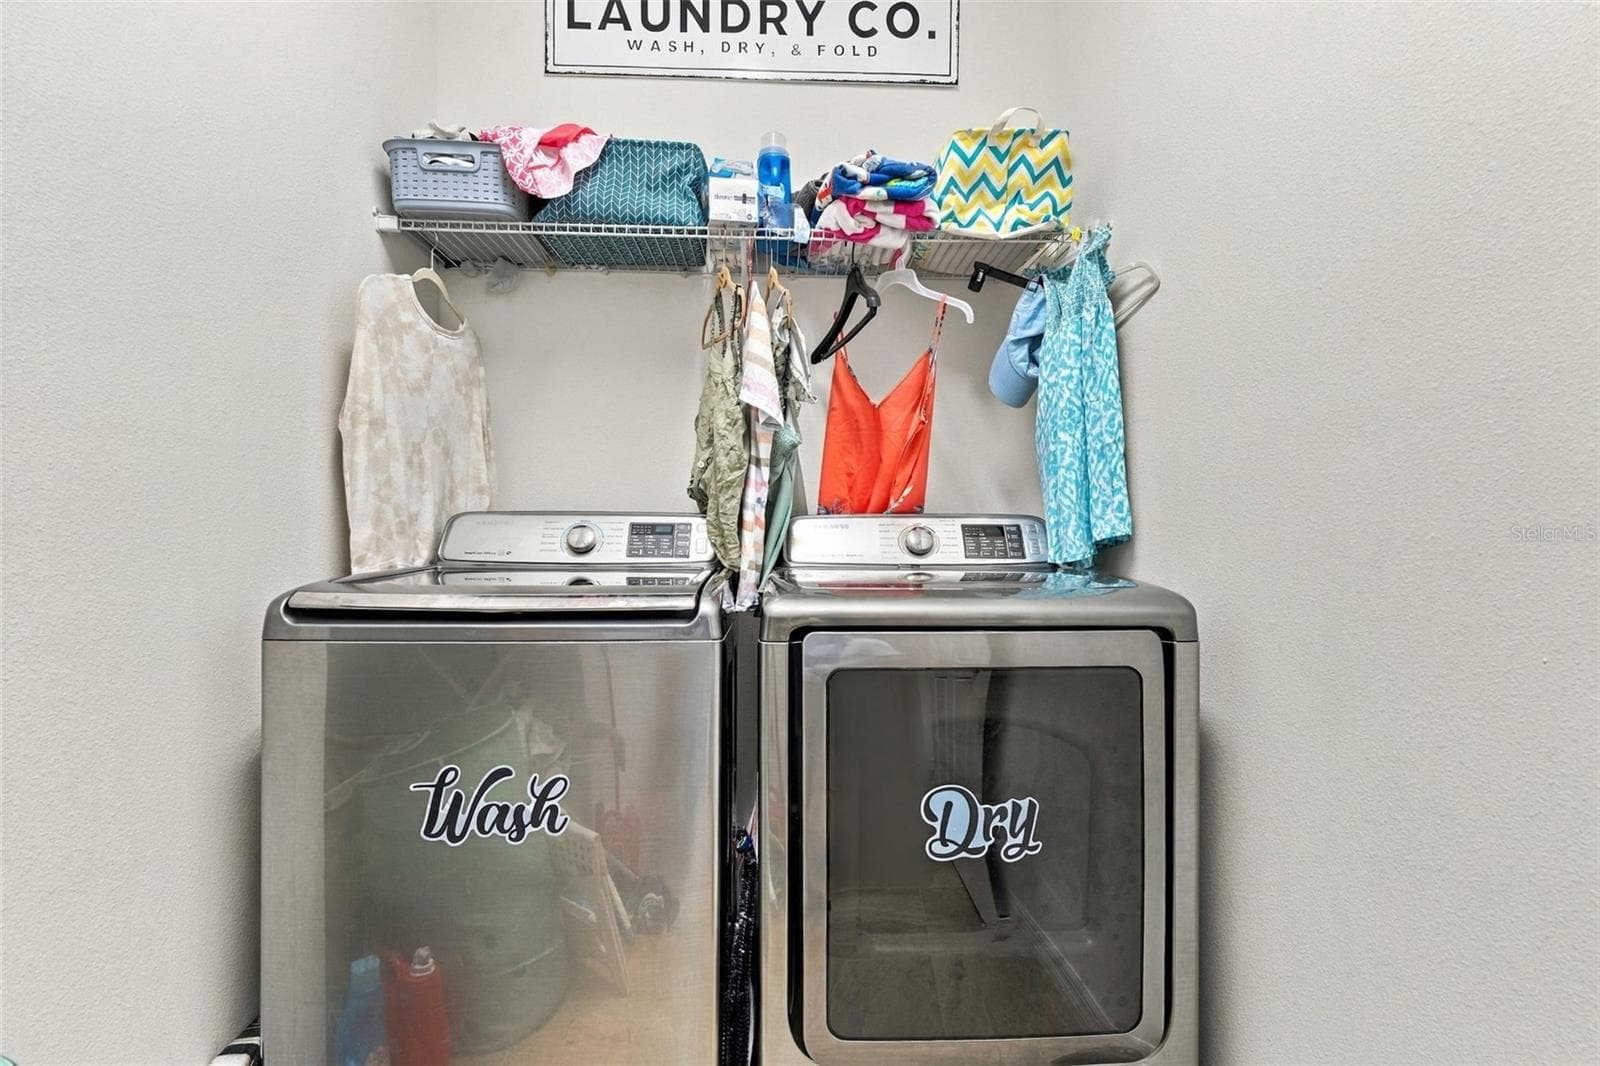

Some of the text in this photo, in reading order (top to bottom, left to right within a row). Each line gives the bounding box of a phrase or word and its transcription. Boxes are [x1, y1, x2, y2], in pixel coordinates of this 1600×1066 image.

[567, 0, 937, 40] LAUNDRY CO.
[626, 39, 878, 58] WASH, DRY, & FOLD
[411, 766, 570, 845] Wash
[922, 785, 1042, 862] Dry
